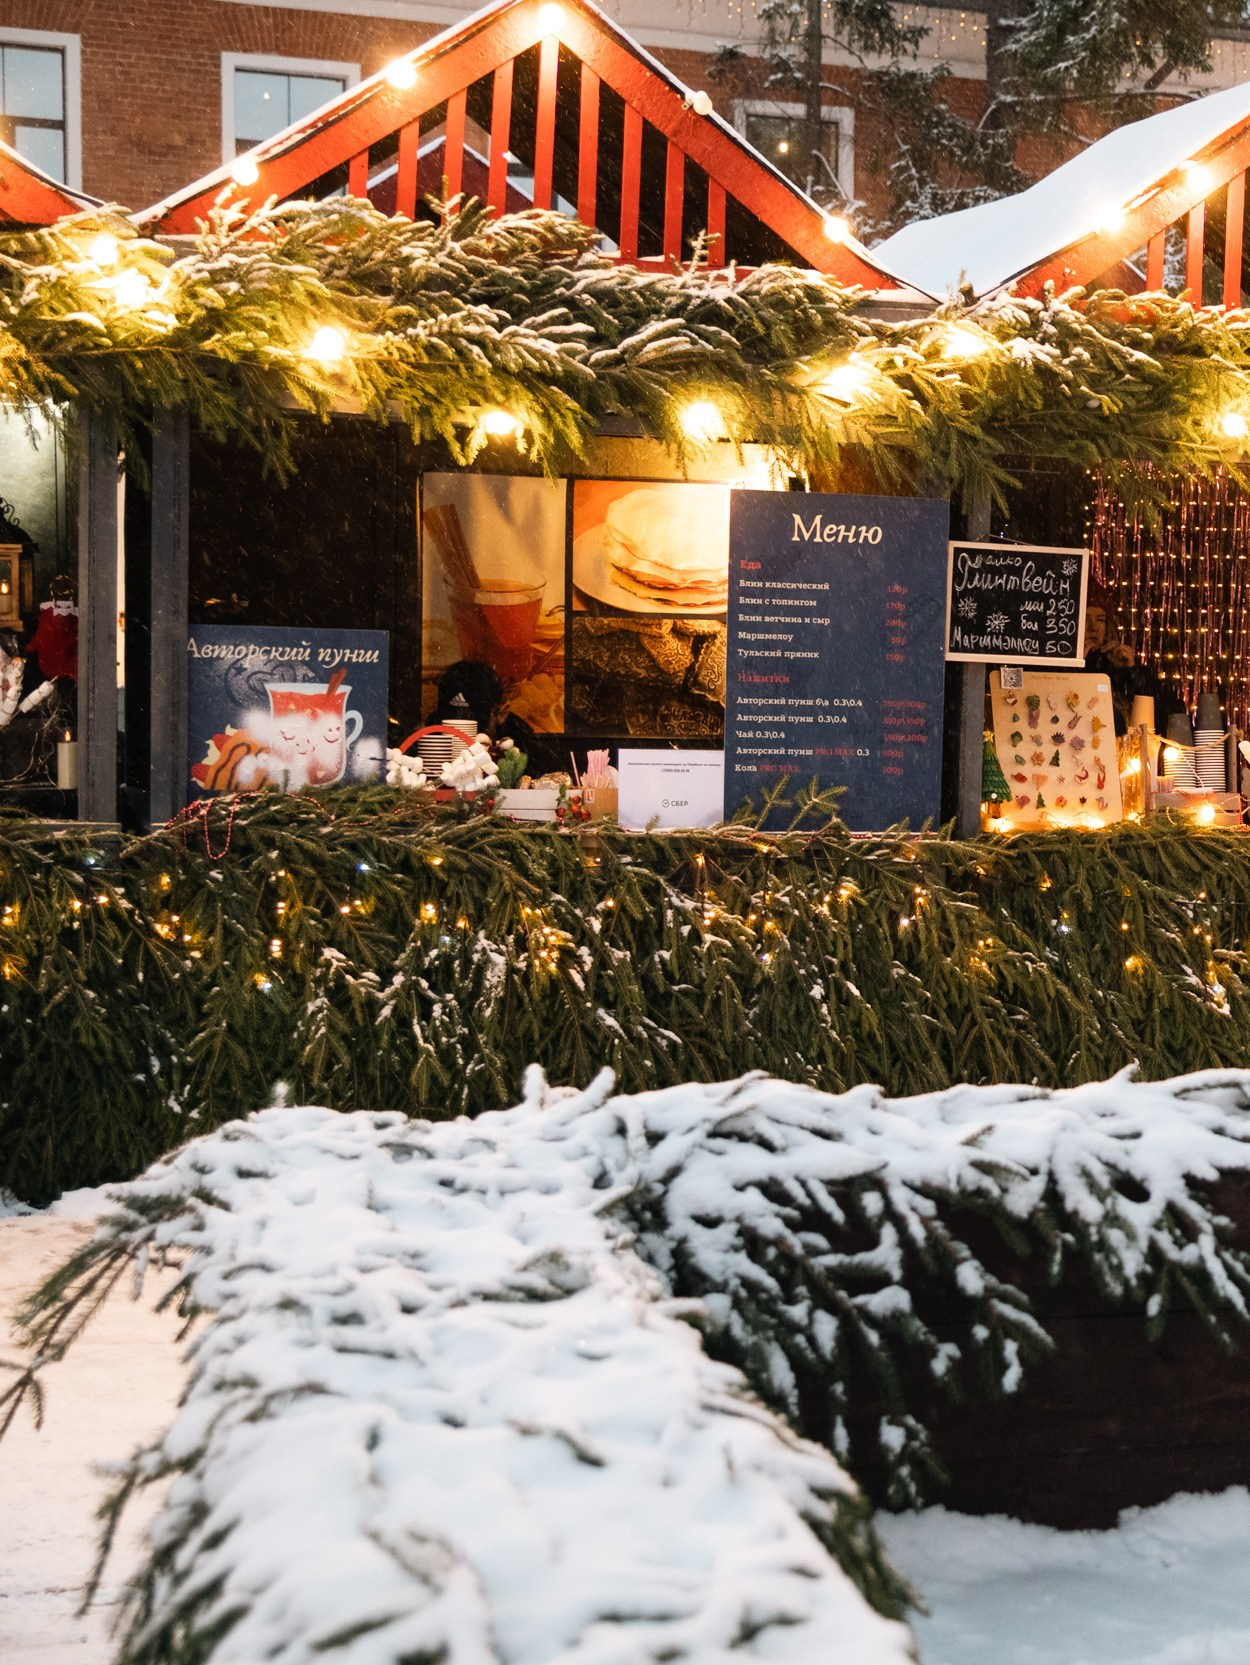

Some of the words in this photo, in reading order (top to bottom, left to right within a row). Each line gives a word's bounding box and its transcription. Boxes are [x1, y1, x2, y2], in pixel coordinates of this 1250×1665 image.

[792, 514, 882, 545] Меню
[740, 559, 762, 571] Еда
[954, 552, 1070, 598] Глинтвейн
[739, 579, 763, 588] Блин
[765, 580, 830, 590] классический
[738, 596, 763, 605] Блин
[772, 598, 817, 607] топингом
[1046, 598, 1075, 617] 250
[738, 614, 763, 622] Блин
[764, 615, 802, 624] ветчина
[804, 616, 811, 624] и
[812, 617, 831, 626] сыр
[1045, 618, 1077, 636] 350
[738, 631, 794, 641] Маршмелоу
[187, 637, 310, 667] Авторский
[318, 648, 380, 669] пунш
[1045, 640, 1073, 655] 50
[737, 648, 782, 658] Тульский
[784, 650, 820, 660] пряник
[737, 673, 790, 683] Напитки
[736, 696, 786, 707] Авторский
[788, 698, 814, 707] пунш
[833, 698, 863, 708] 0.3\0.4
[736, 713, 786, 724] Авторский
[788, 715, 814, 724] пунш
[817, 715, 847, 724] 0.3\0.4
[736, 730, 754, 739] Чай
[755, 730, 785, 739] 0.3\0.4
[736, 746, 785, 757] Авторский
[787, 748, 813, 757] пунш
[856, 748, 870, 756] 0.3
[735, 763, 758, 773] Кола
